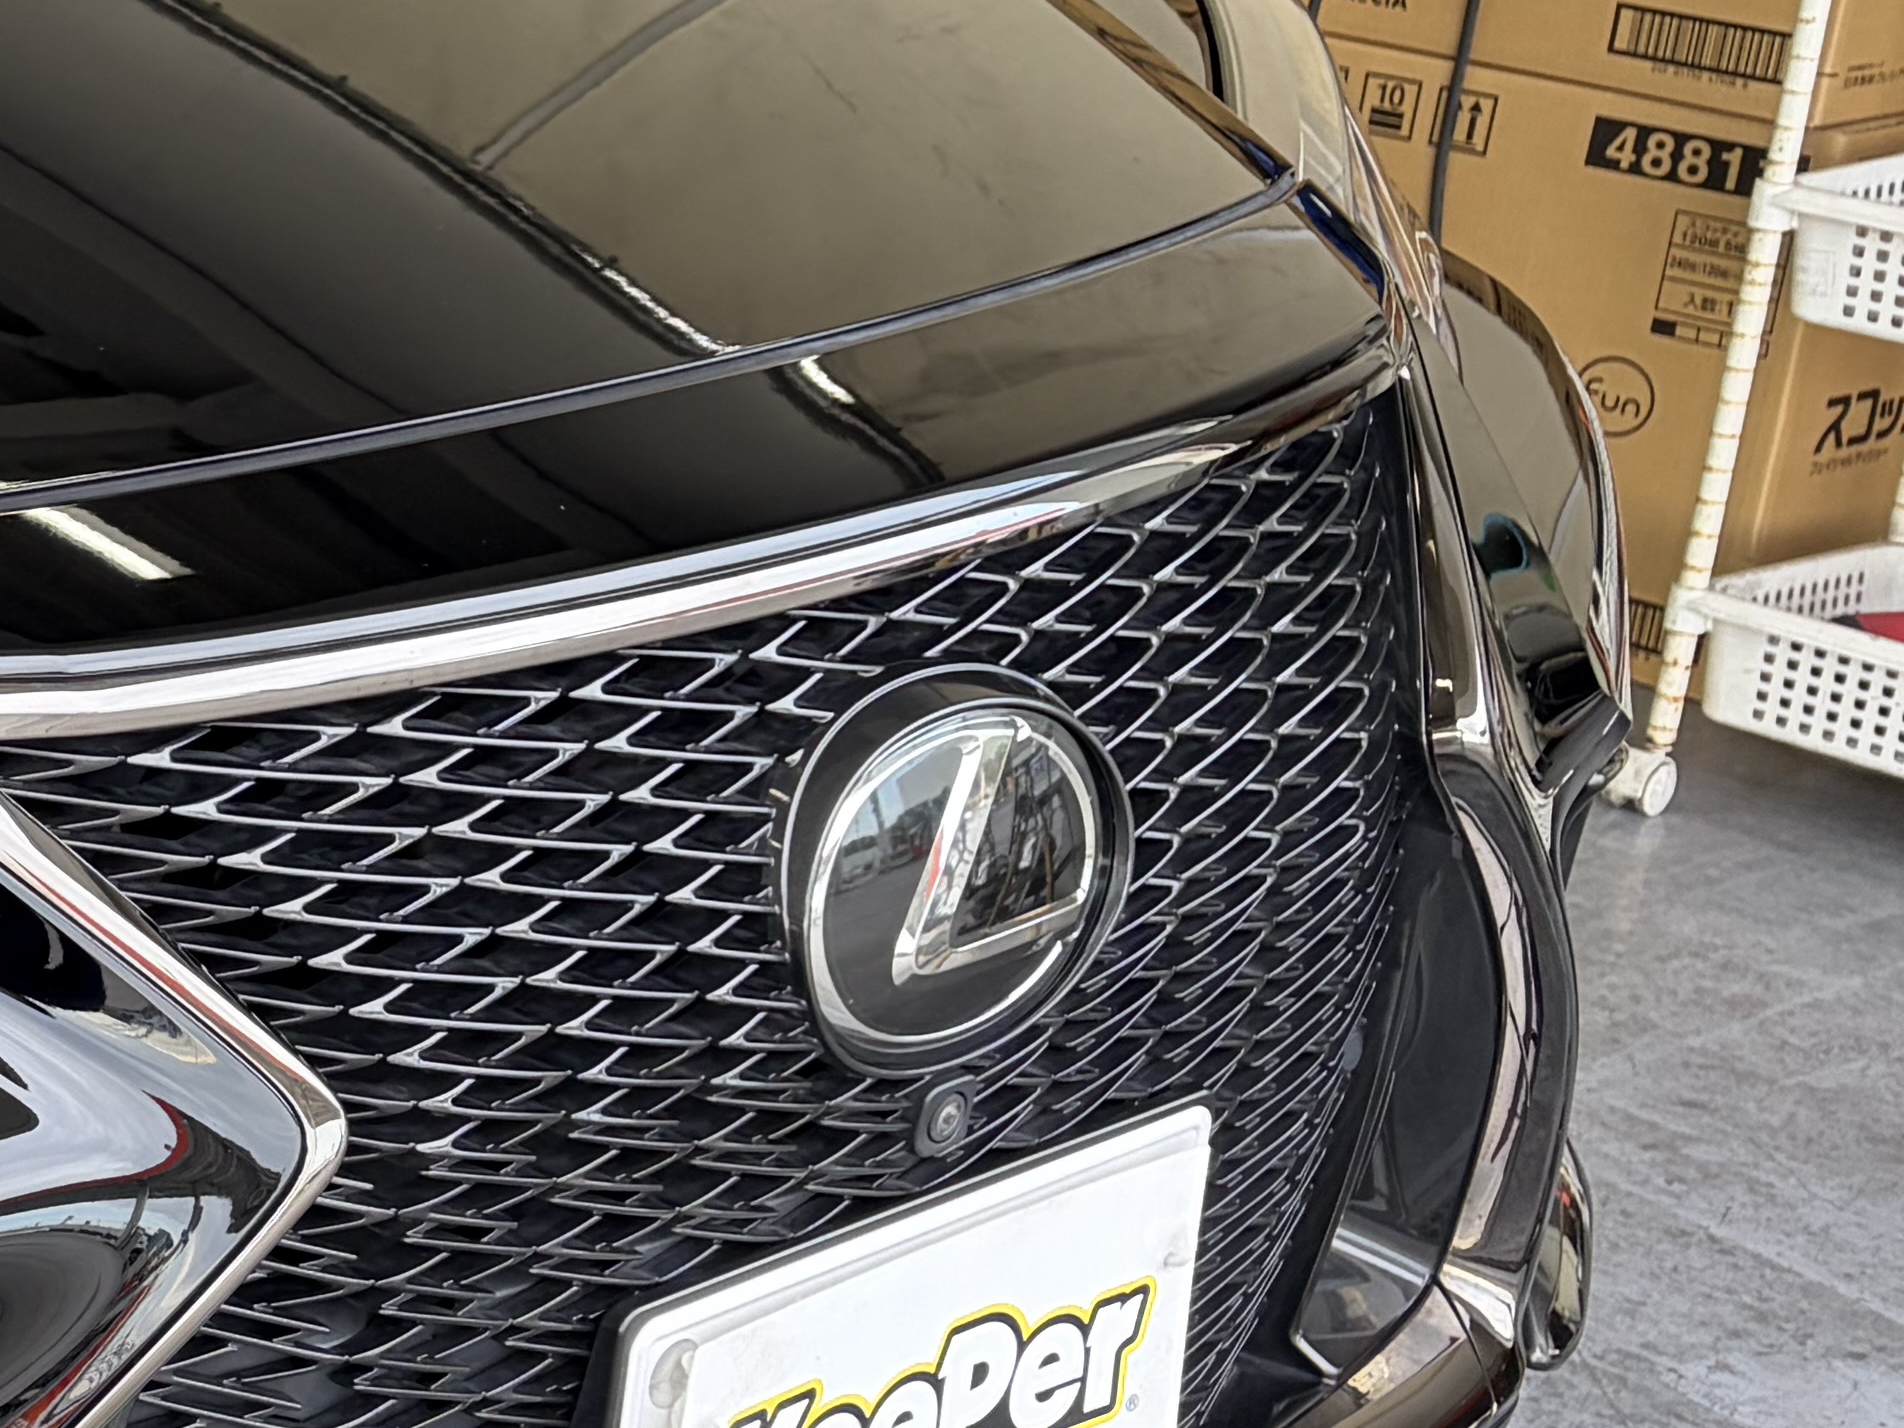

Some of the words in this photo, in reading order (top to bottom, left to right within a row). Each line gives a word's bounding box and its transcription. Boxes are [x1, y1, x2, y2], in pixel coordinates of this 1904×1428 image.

[1378, 80, 1405, 108] 10
[1605, 125, 1769, 192] 4881
[1813, 387, 1904, 456] スコッ
